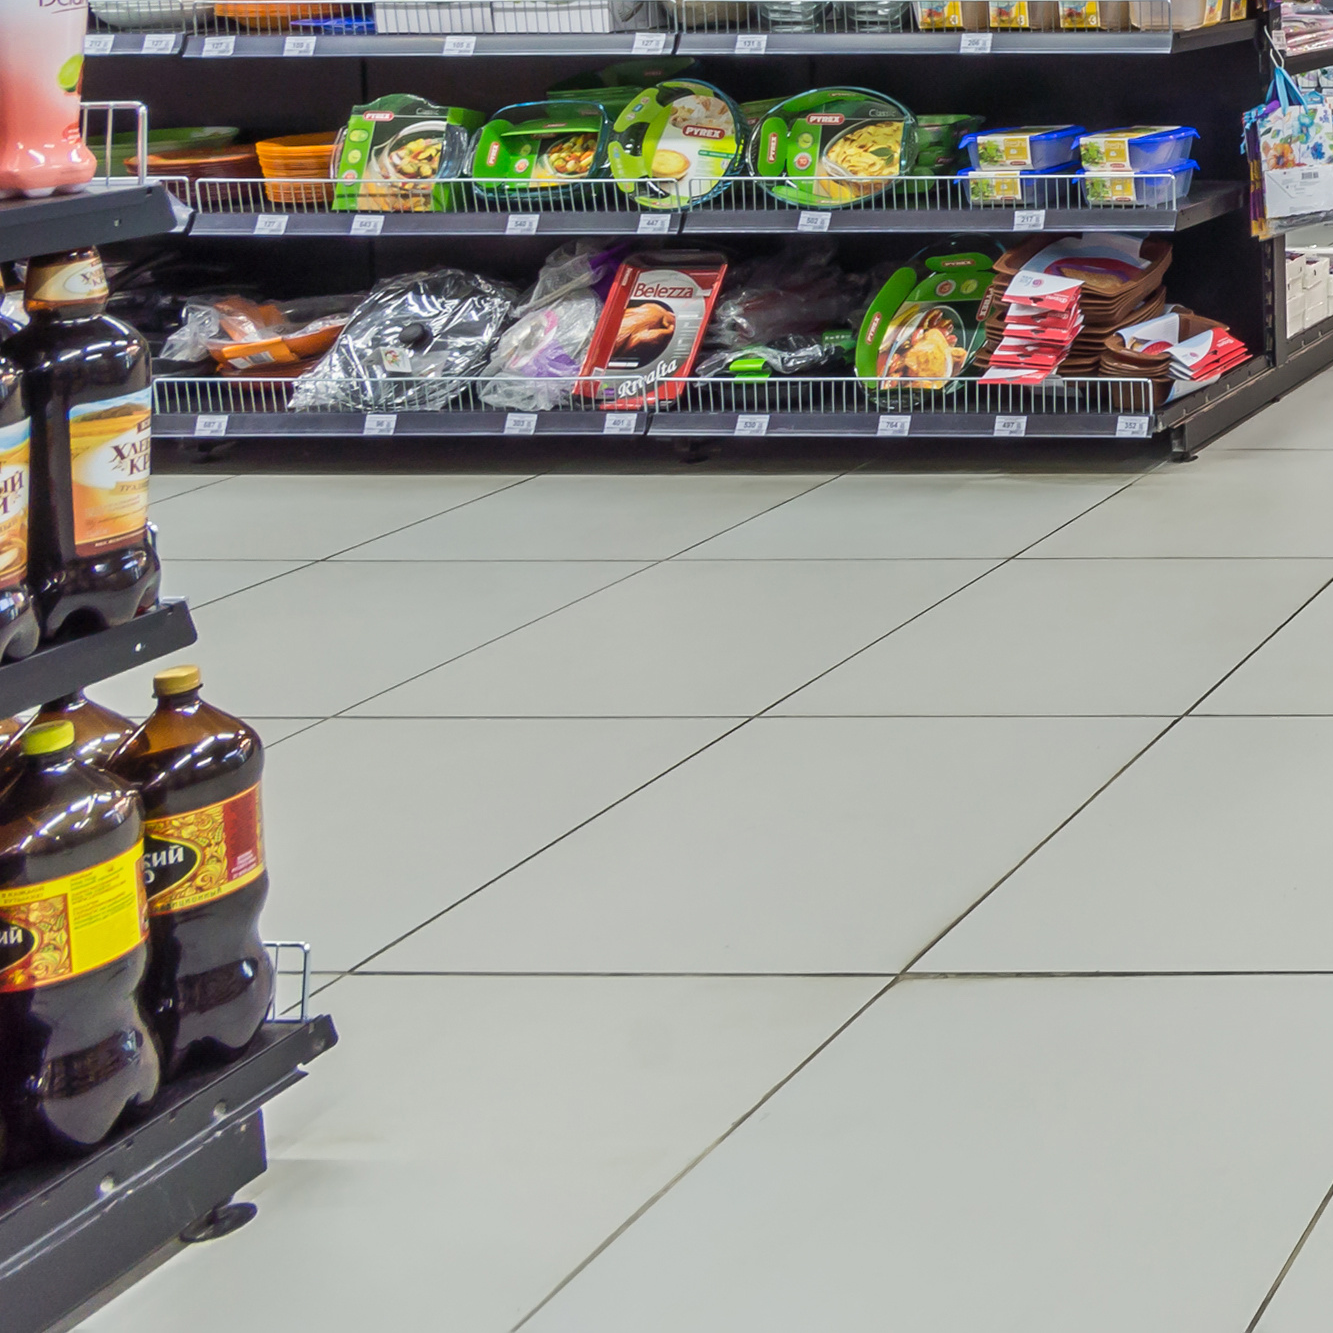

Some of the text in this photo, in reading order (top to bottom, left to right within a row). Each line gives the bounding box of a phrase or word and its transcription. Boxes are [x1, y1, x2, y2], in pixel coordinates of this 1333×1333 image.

[211, 42, 224, 50] 127
[640, 39, 654, 47] 127
[742, 39, 755, 47] 131
[808, 115, 843, 124] PYREX
[685, 127, 723, 139] PYREX
[769, 134, 777, 162] PYREX
[646, 219, 659, 227] 447
[1020, 215, 1034, 223] 217
[633, 281, 694, 299] Belezza
[866, 313, 881, 344] PYREX
[618, 359, 678, 399] Rivalta
[611, 419, 625, 427] 401
[885, 421, 899, 429] 764
[1001, 421, 1015, 430] 497
[1124, 421, 1137, 430] 352
